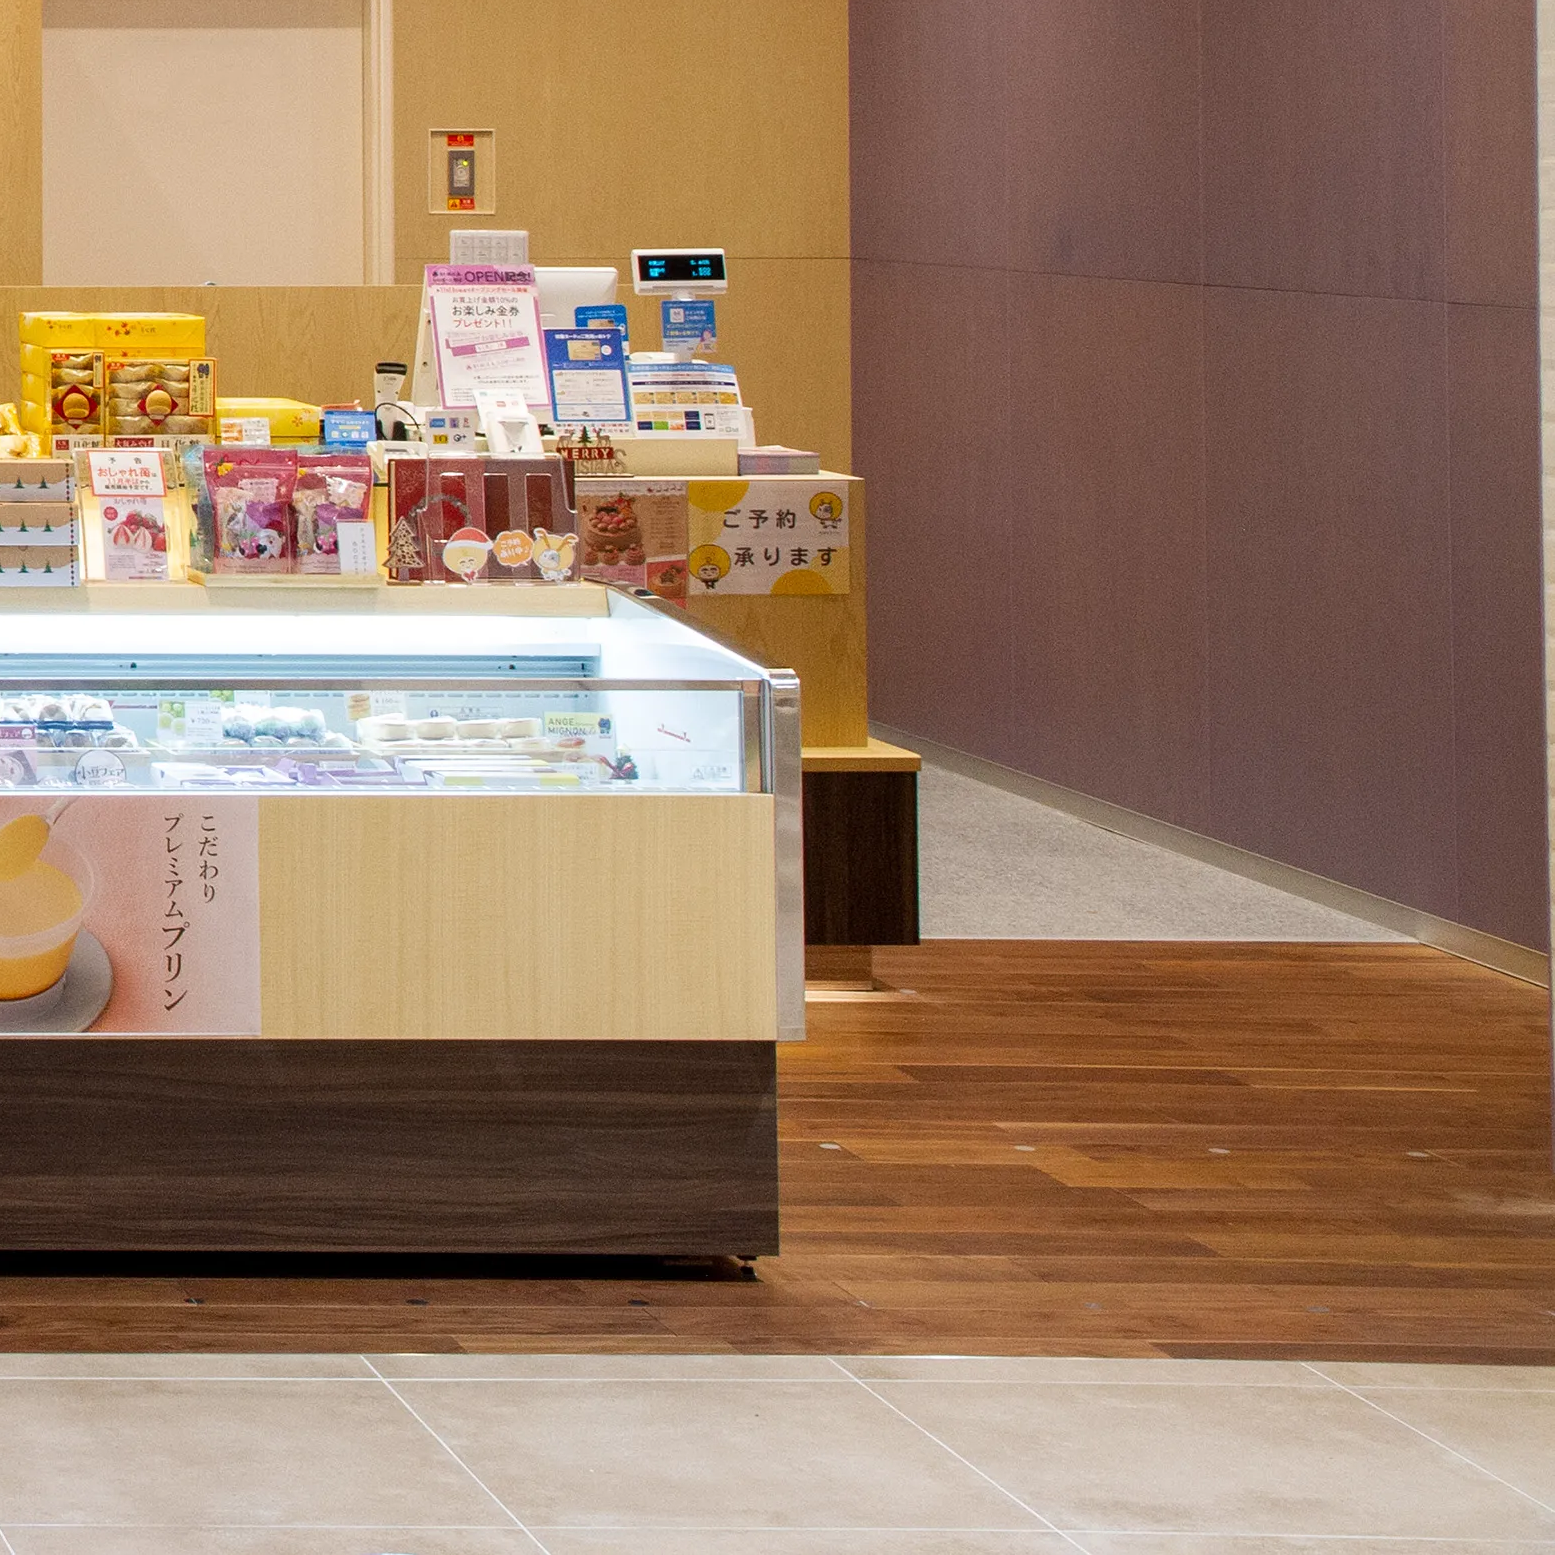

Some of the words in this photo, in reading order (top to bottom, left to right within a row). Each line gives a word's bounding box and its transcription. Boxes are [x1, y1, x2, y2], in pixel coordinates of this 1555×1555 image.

[723, 509, 796, 529] ご予約
[735, 547, 837, 566] 承ります
[548, 717, 574, 726] ANGE
[198, 814, 219, 904] こだわり
[161, 813, 190, 1013] プレミアムプリン
